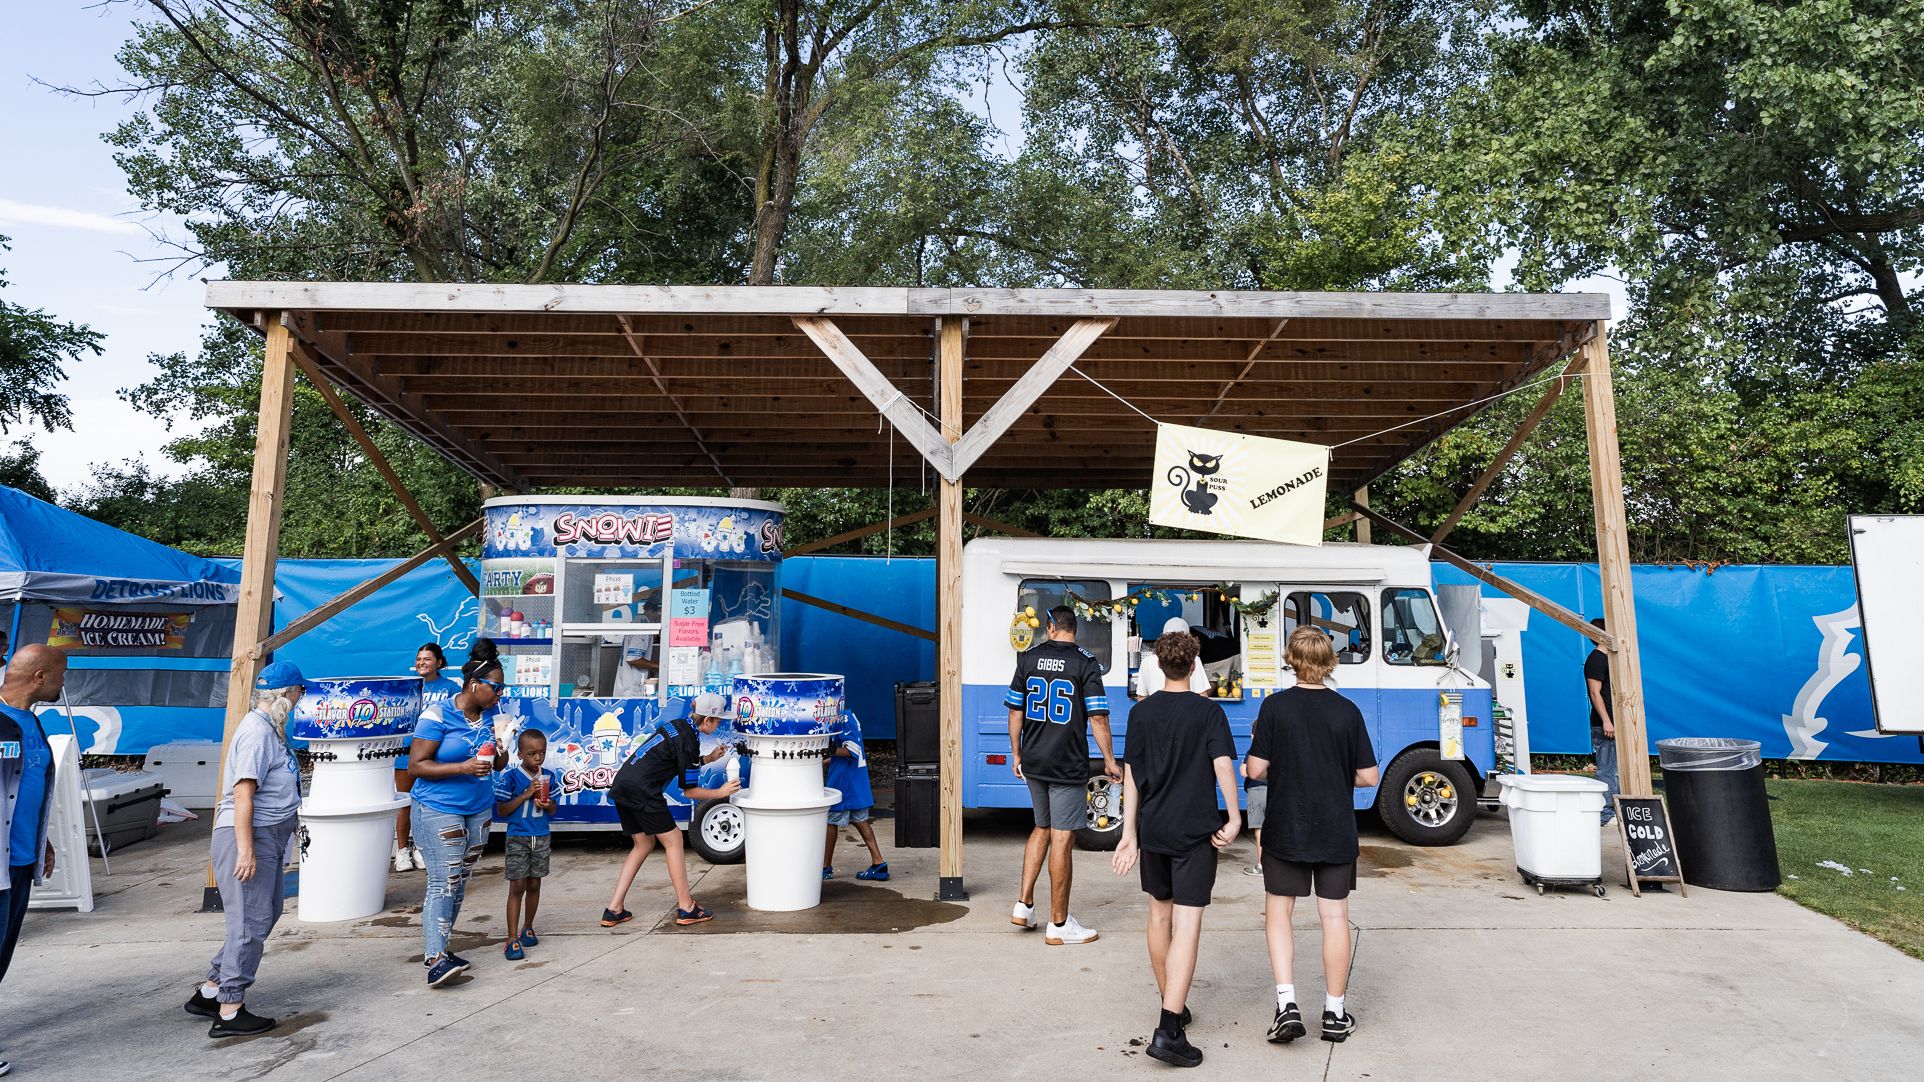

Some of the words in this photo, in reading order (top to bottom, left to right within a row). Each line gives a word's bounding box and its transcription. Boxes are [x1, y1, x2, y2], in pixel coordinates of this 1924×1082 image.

[1209, 476, 1228, 485] SOUR
[1250, 467, 1323, 510] LEMONADE
[554, 513, 674, 546] SNOWIE
[181, 583, 226, 601] LIONS
[684, 606, 696, 616] $3
[80, 614, 168, 630] HOMEMADE
[81, 631, 104, 646] ICE
[107, 631, 166, 646] CREAM!
[1037, 658, 1066, 672] GIBBS
[521, 686, 549, 698] LIONS
[679, 686, 707, 697] LIONS
[1026, 676, 1074, 725] 26
[319, 707, 348, 720] FLAVOR
[353, 703, 375, 721] 10
[379, 706, 405, 718] STATION
[1626, 806, 1653, 821] ICE
[1628, 823, 1664, 840] COLD
